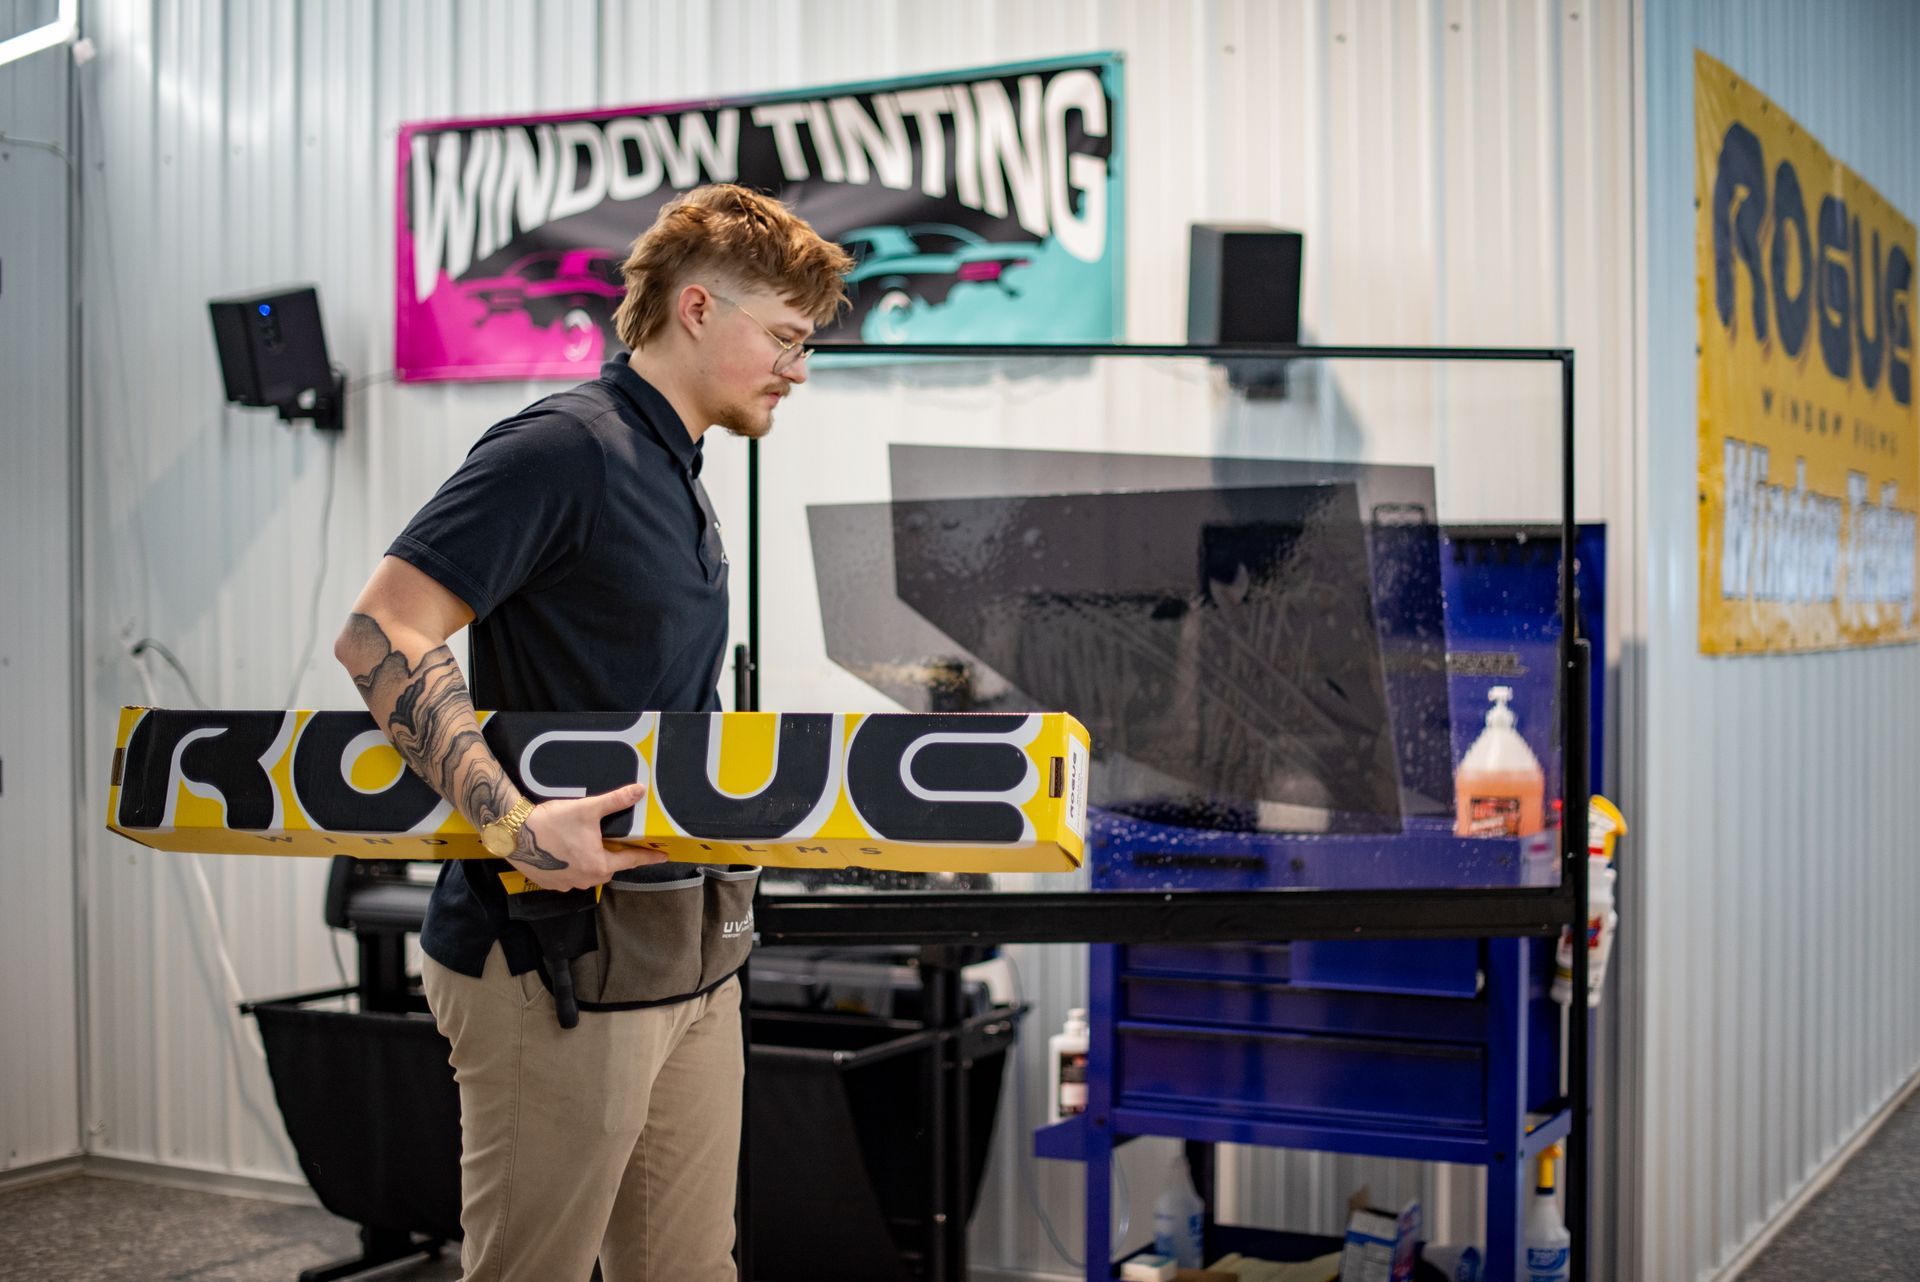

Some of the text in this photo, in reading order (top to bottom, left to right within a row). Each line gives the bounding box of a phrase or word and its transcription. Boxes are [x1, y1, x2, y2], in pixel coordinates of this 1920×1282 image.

[411, 69, 1109, 303] WINDOW TINTING
[1713, 121, 1913, 407] ROGUE
[115, 709, 1039, 845] ROGUE
[256, 834, 882, 855] WIND FILMS
[1069, 752, 1077, 818] ROGUE
